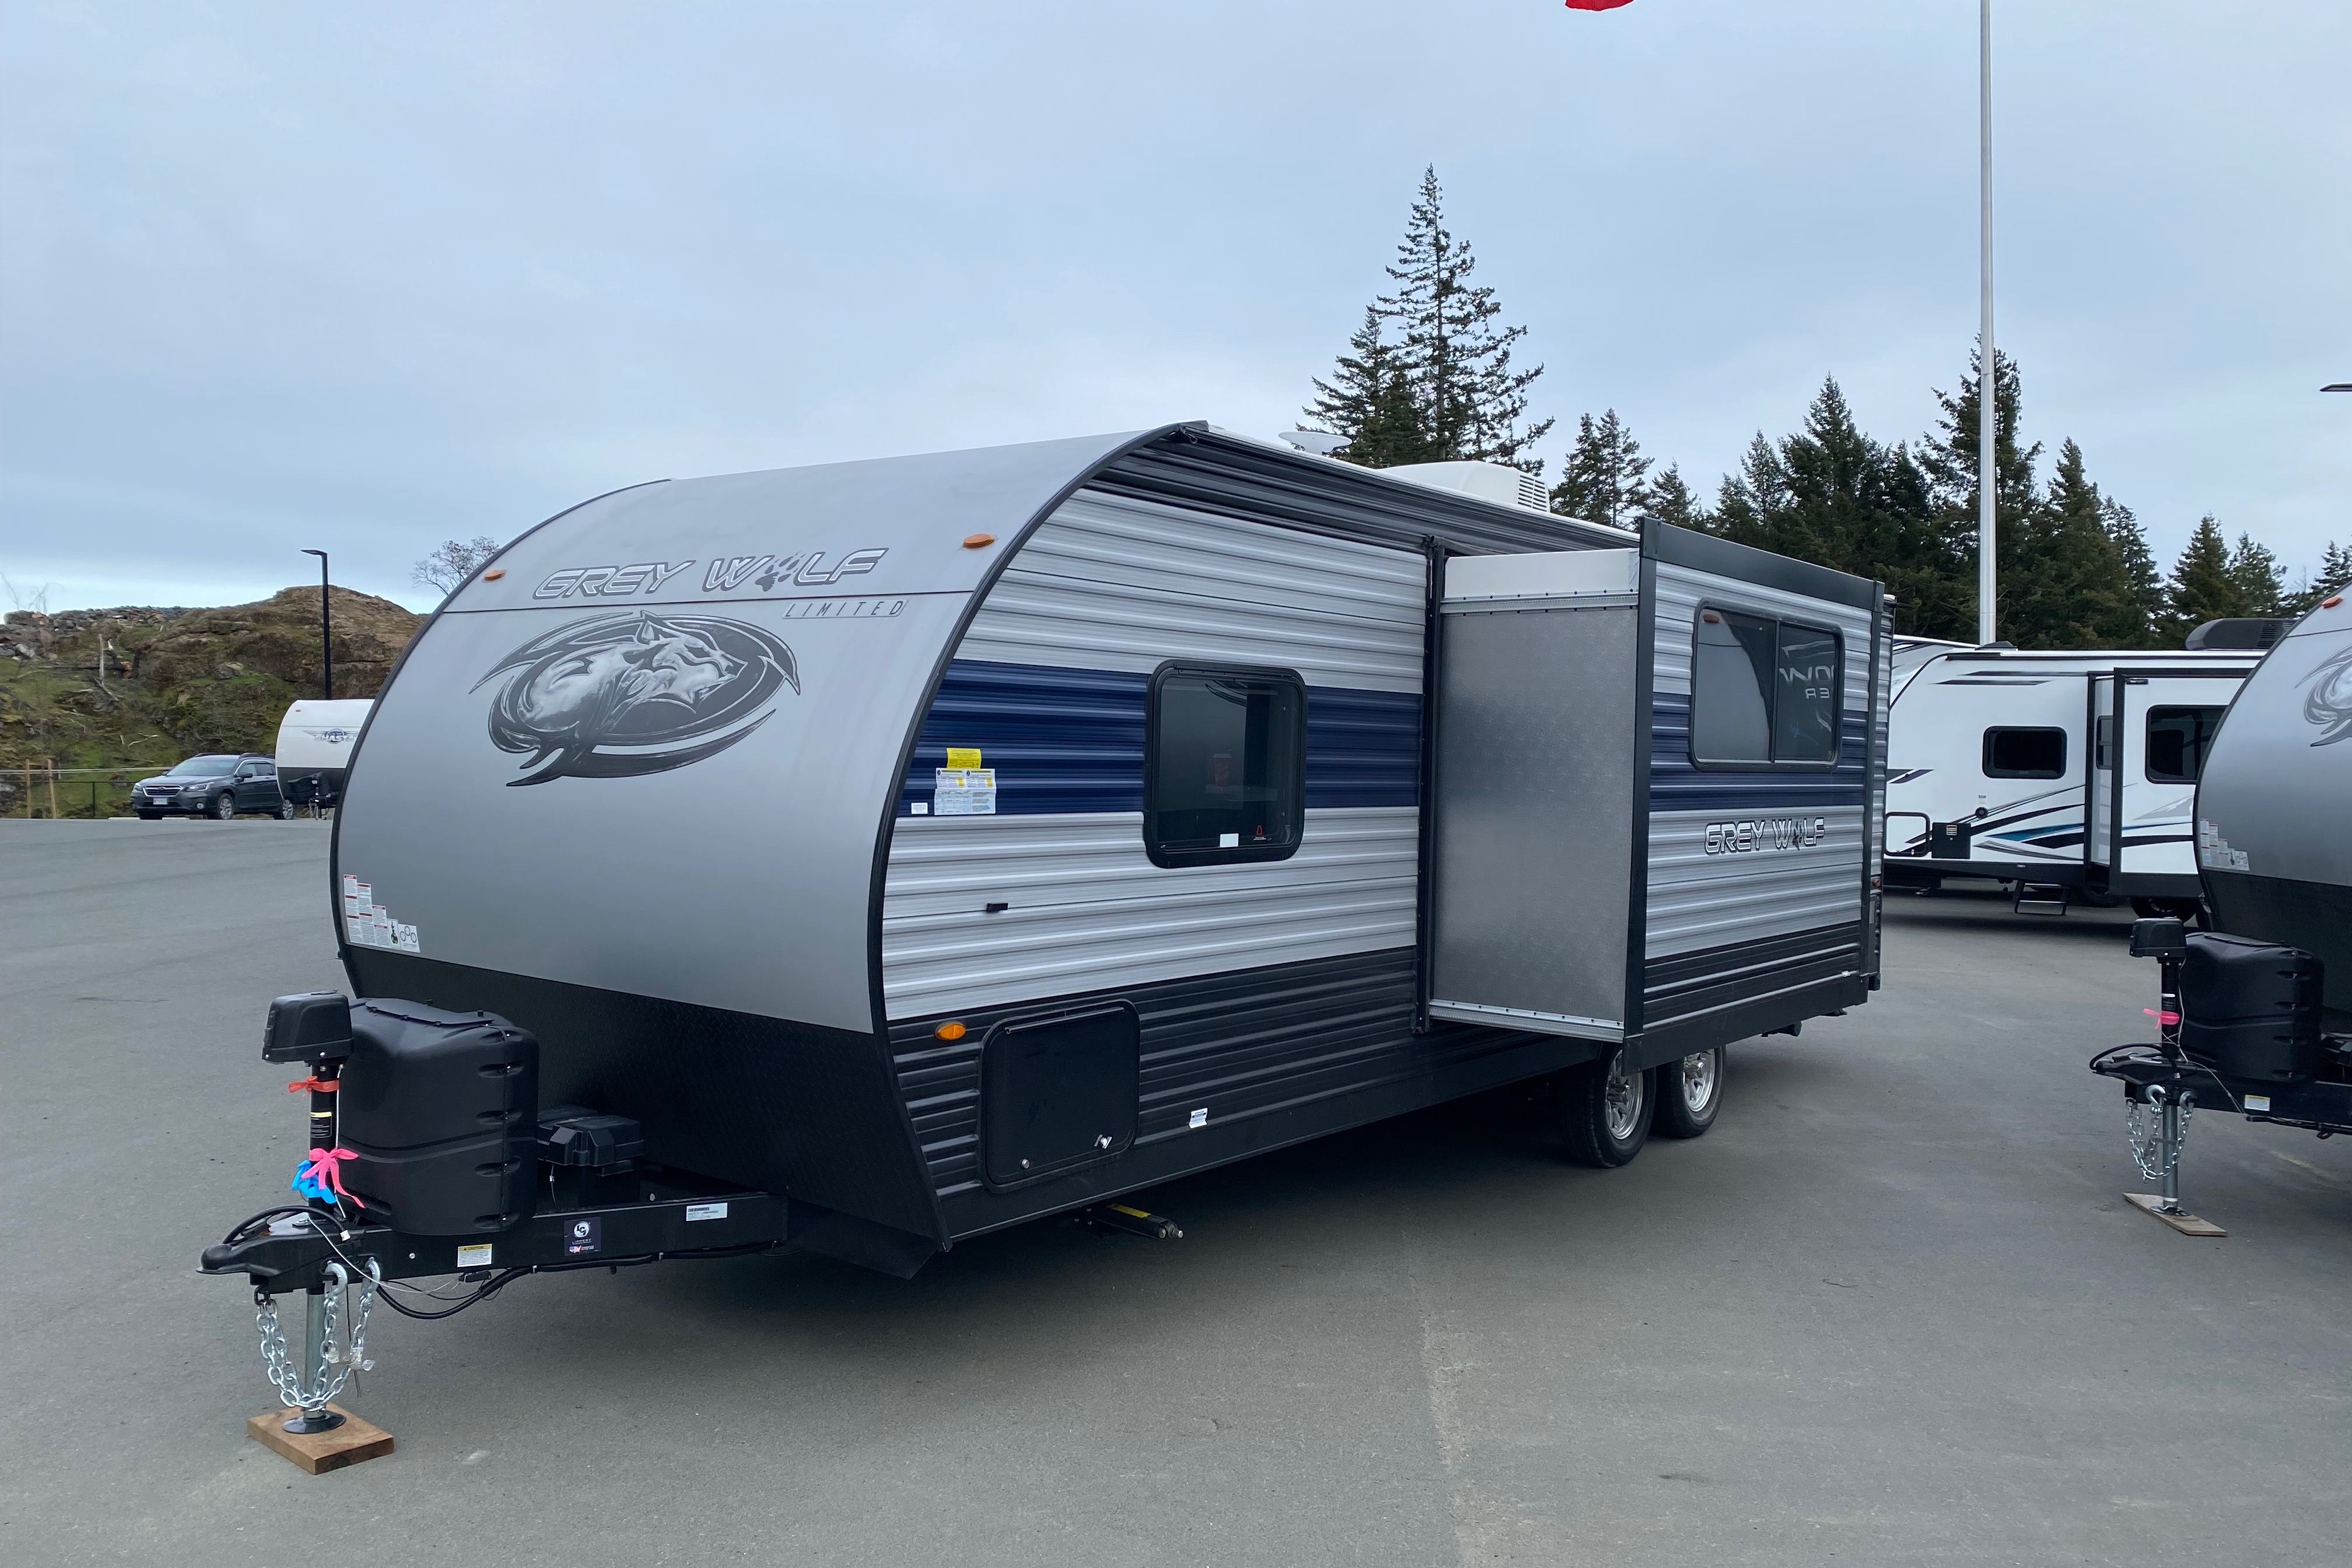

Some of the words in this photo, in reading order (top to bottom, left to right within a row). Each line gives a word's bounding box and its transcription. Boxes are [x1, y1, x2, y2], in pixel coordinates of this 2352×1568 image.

[533, 560, 696, 599] GREY
[785, 600, 903, 617] LIMITED
[1705, 819, 1765, 854] GREY
